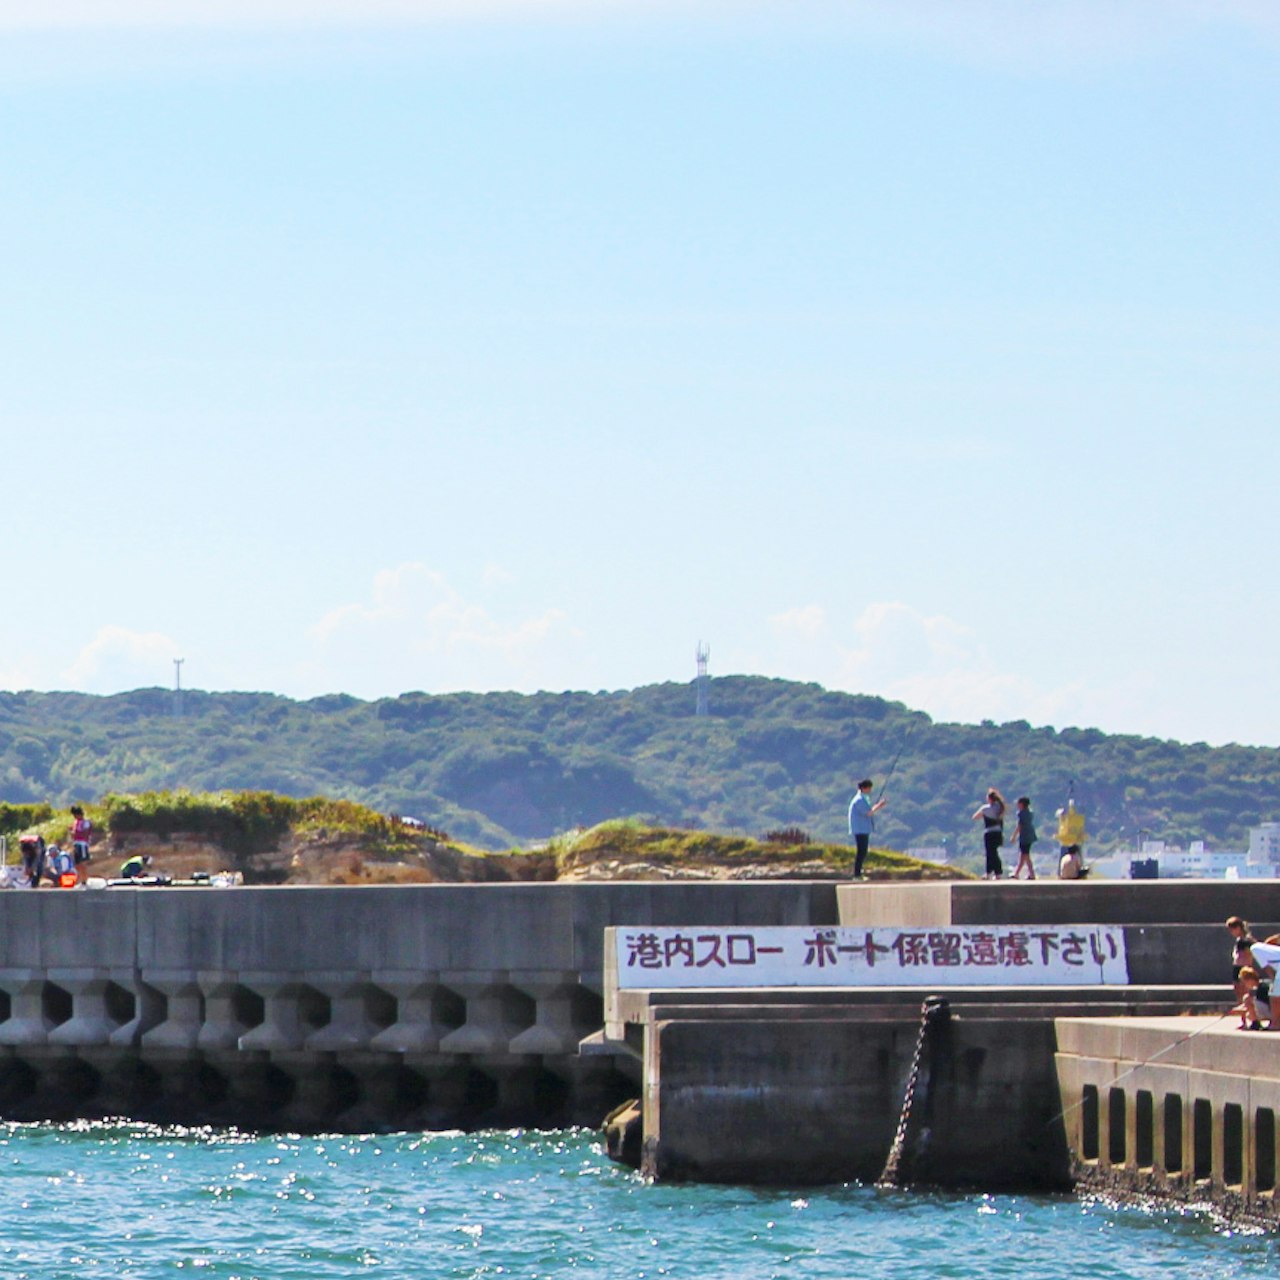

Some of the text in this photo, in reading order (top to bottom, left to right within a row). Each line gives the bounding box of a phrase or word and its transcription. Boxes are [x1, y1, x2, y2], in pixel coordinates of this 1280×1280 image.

[626, 931, 1118, 969] 港内スロー ボート係留遠慮下さい
